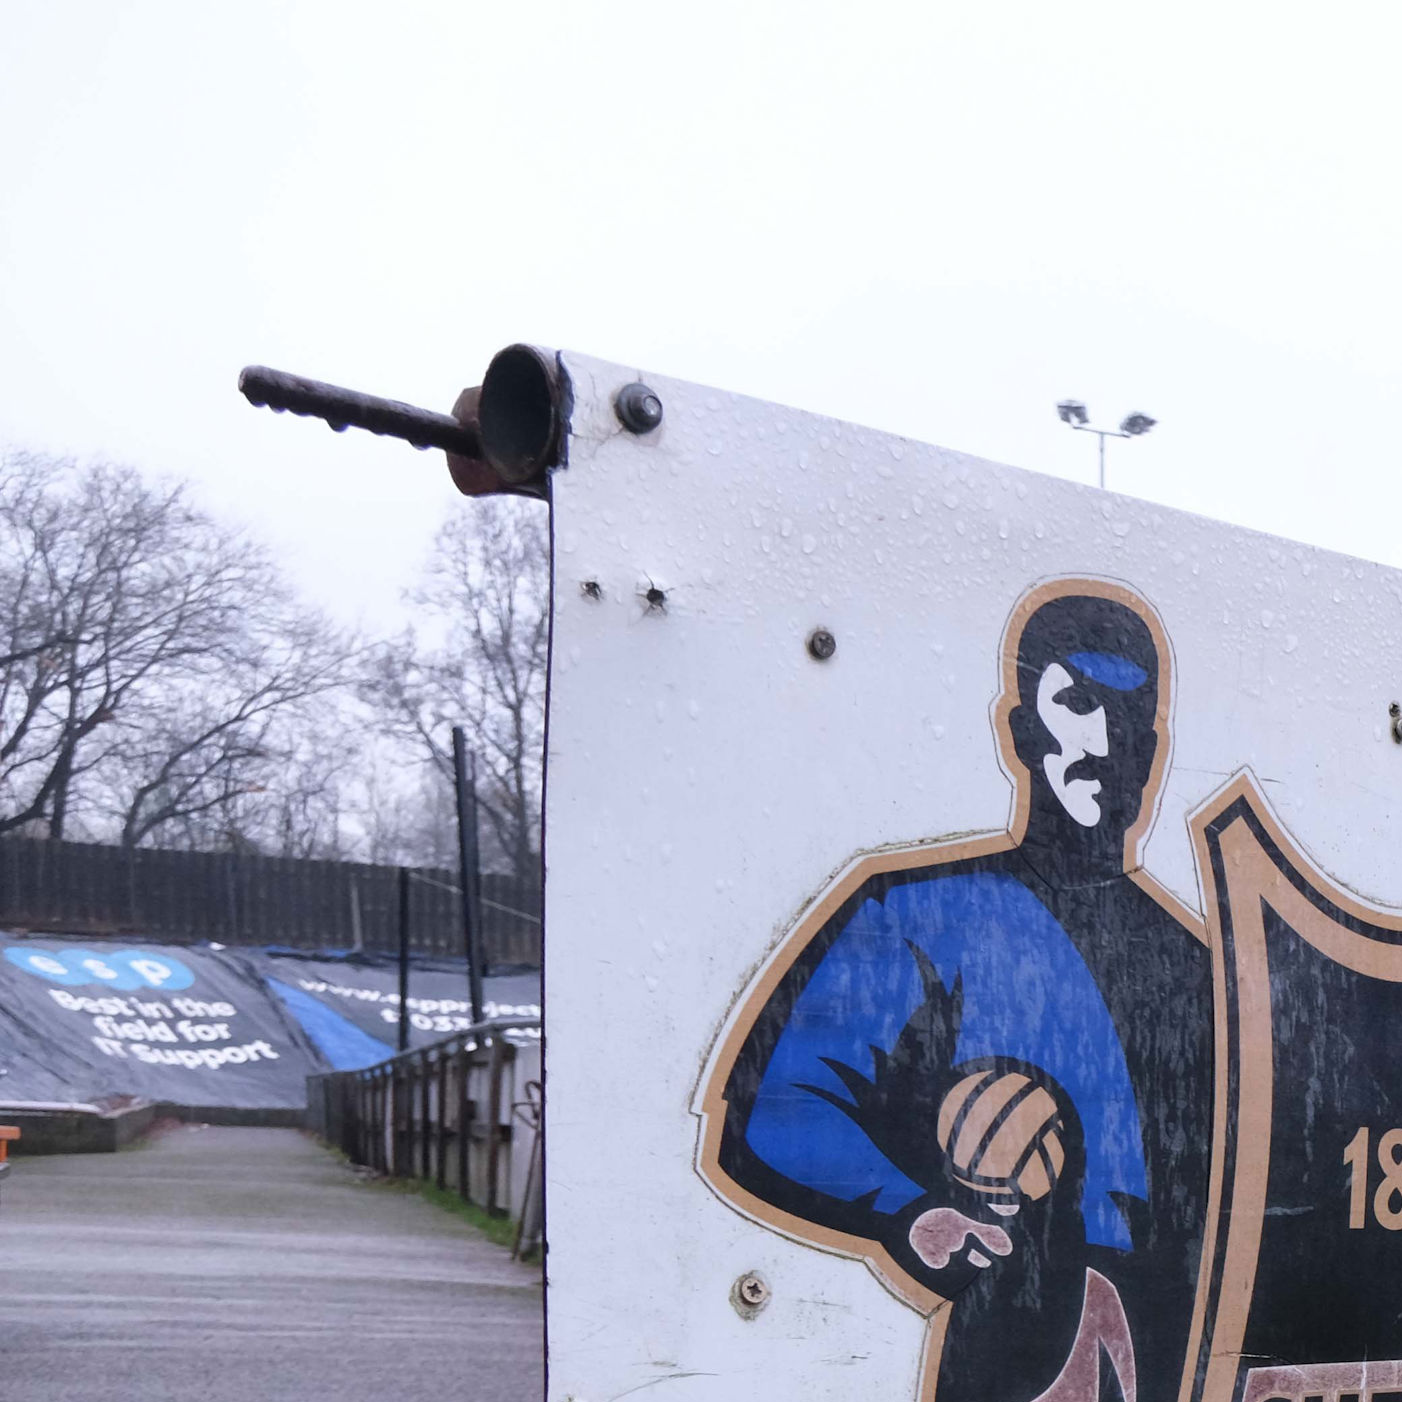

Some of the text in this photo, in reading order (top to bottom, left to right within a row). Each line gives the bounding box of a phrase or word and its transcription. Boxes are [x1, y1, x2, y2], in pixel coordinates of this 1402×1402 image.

[28, 955, 172, 986] esp
[48, 989, 236, 1018] Best in the
[93, 1016, 232, 1043] field for
[91, 1036, 280, 1069] IT Support
